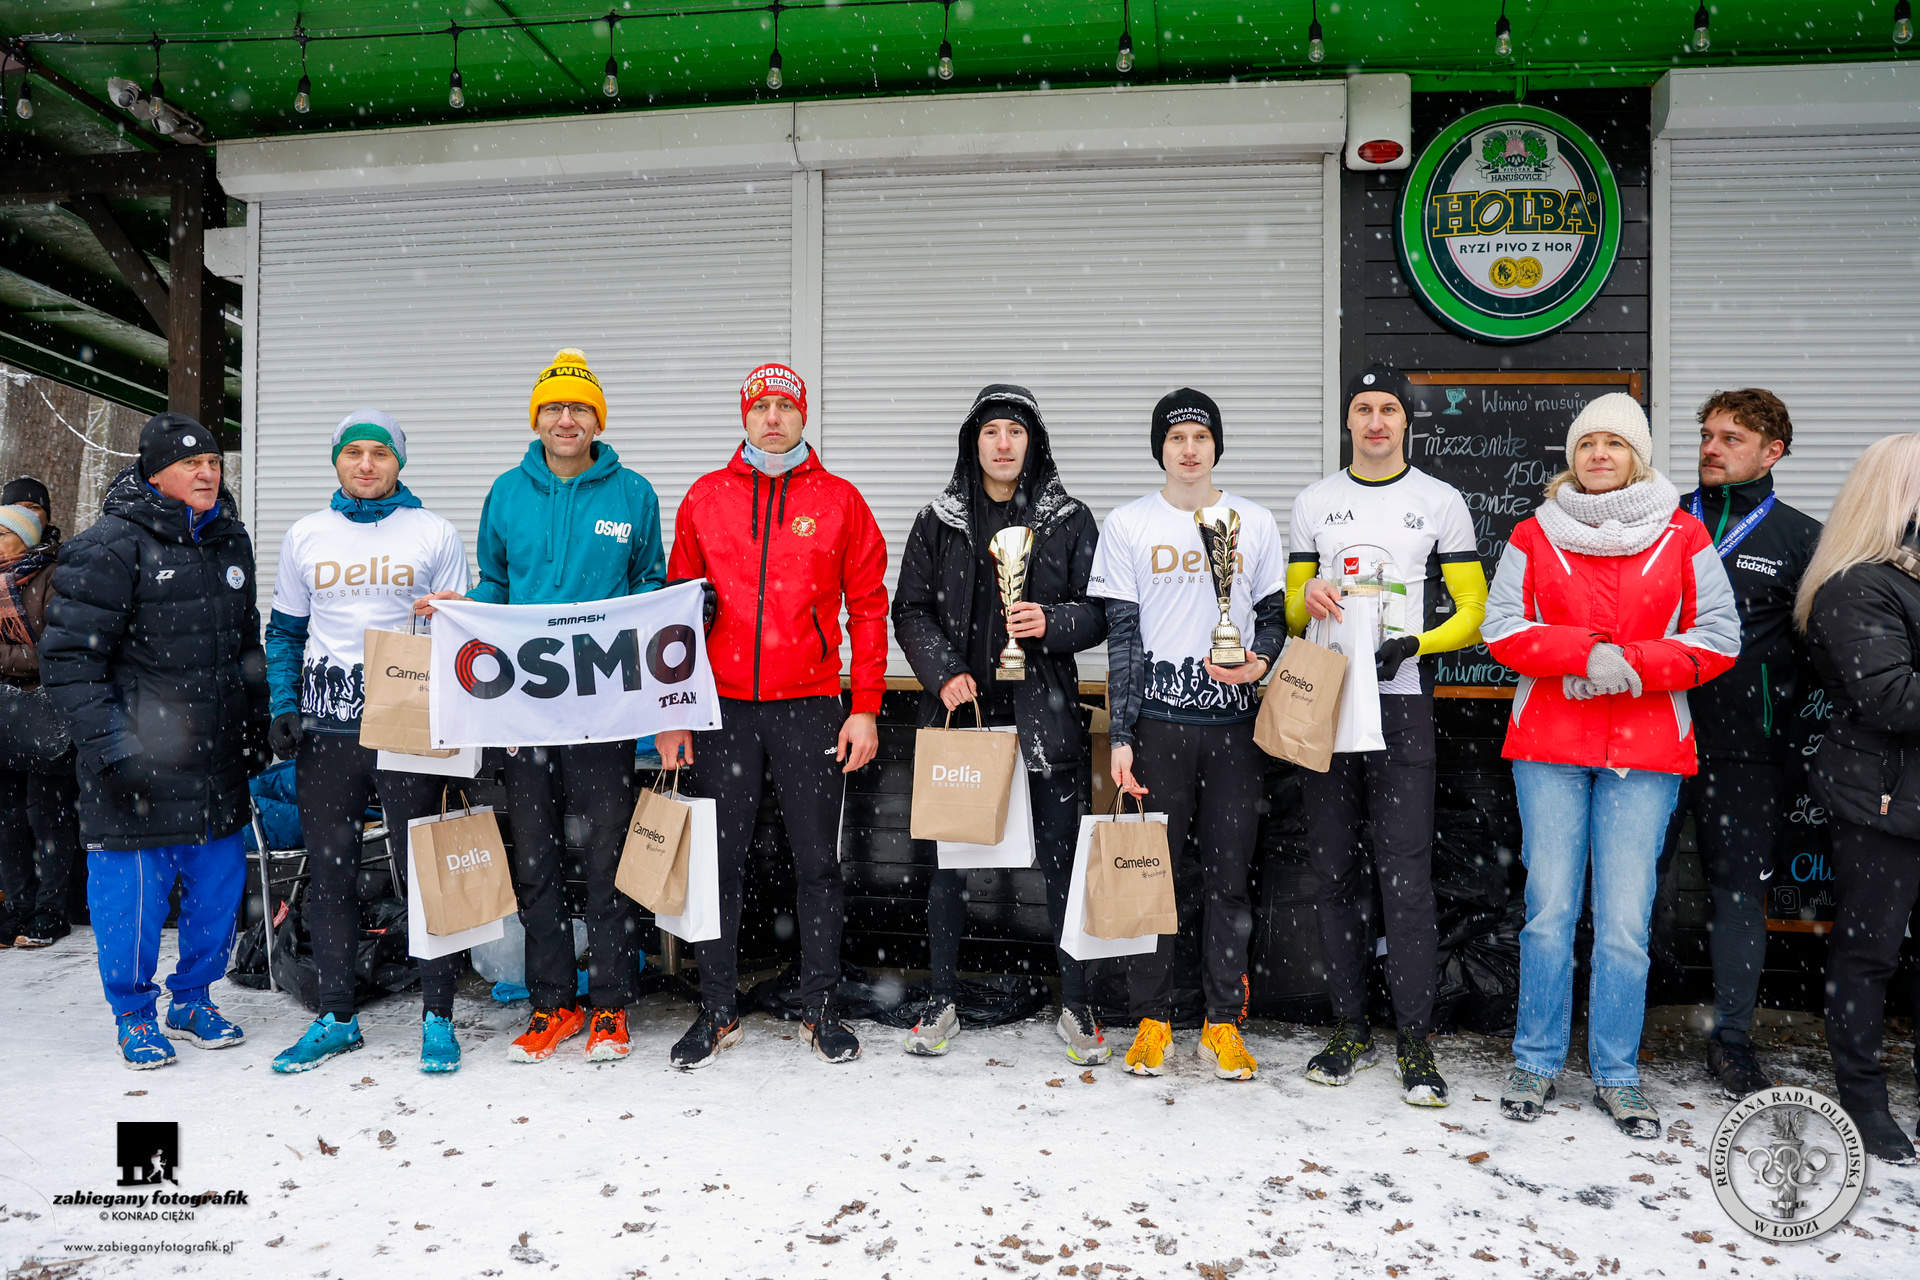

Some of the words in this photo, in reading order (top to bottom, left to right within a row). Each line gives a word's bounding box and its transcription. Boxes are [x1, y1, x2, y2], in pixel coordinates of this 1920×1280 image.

[1432, 189, 1597, 238] HOLBA
[1459, 240, 1490, 254] RYZÍ
[1495, 242, 1528, 252] PIVO
[1531, 242, 1542, 252] Z
[1544, 241, 1573, 252] HOR
[594, 519, 632, 538] OSMO
[314, 555, 414, 590] Delia
[317, 588, 413, 600] COSMETICS
[454, 624, 697, 700] OSMO
[386, 665, 430, 681] Camel
[1279, 669, 1314, 693] Cameleo
[931, 764, 982, 783] Delia
[633, 821, 665, 844] Cameleo
[445, 848, 491, 871] Delia
[1113, 856, 1160, 869] Cameleo
